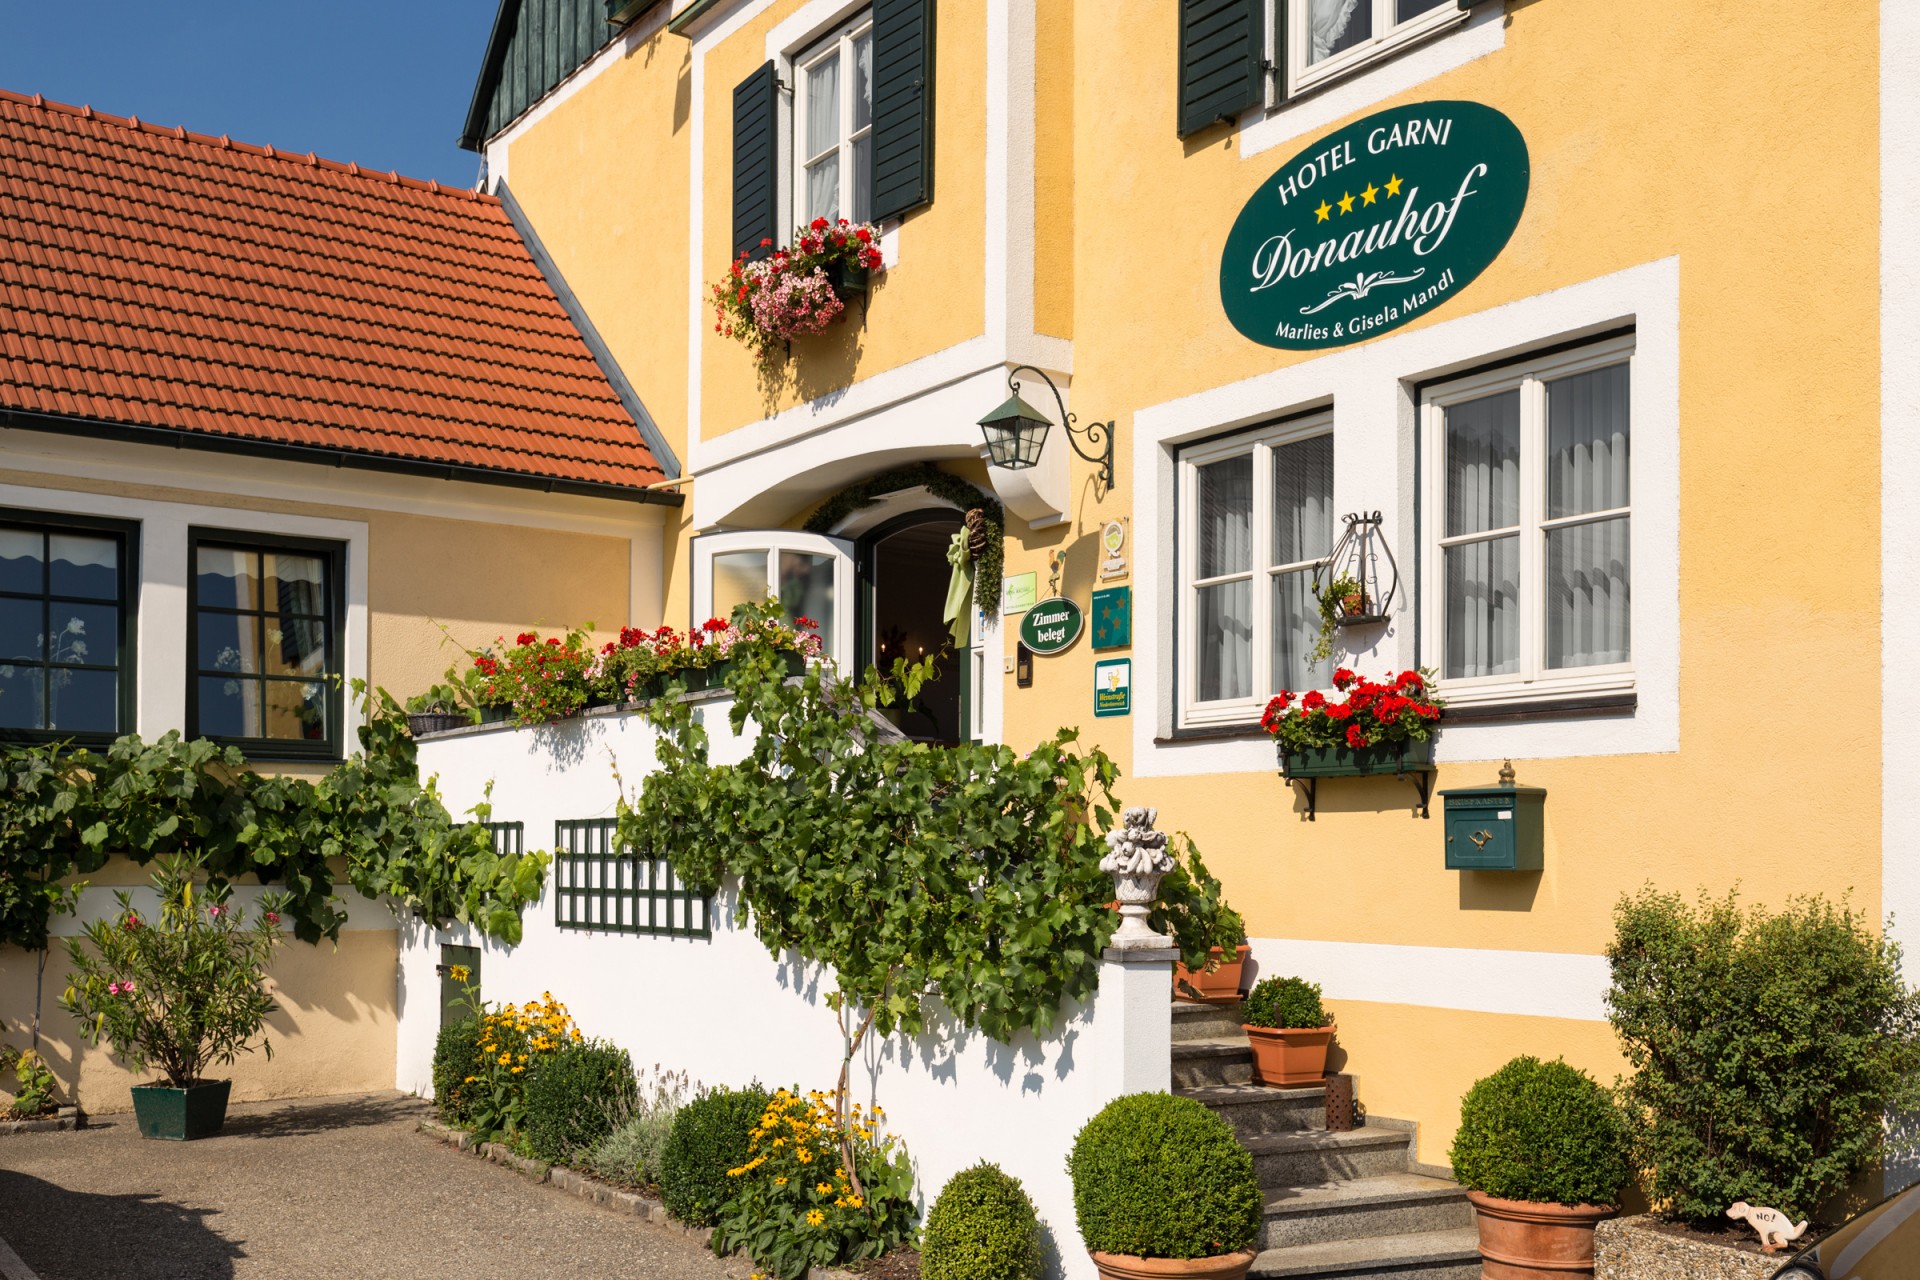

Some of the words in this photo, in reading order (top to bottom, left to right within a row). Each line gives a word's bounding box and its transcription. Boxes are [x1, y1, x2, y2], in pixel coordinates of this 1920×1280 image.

[1278, 141, 1356, 206] HOTEL
[1367, 118, 1452, 155] GARNI
[1249, 163, 1487, 293] Donauhof
[1275, 322, 1329, 340] Marlies
[1332, 322, 1344, 338] &
[1349, 306, 1399, 334] Gisela
[1403, 268, 1455, 313] Mandl
[1033, 609, 1070, 627] Zimmer
[1037, 626, 1066, 644] belegt
[1756, 1213, 1776, 1222] NO!
